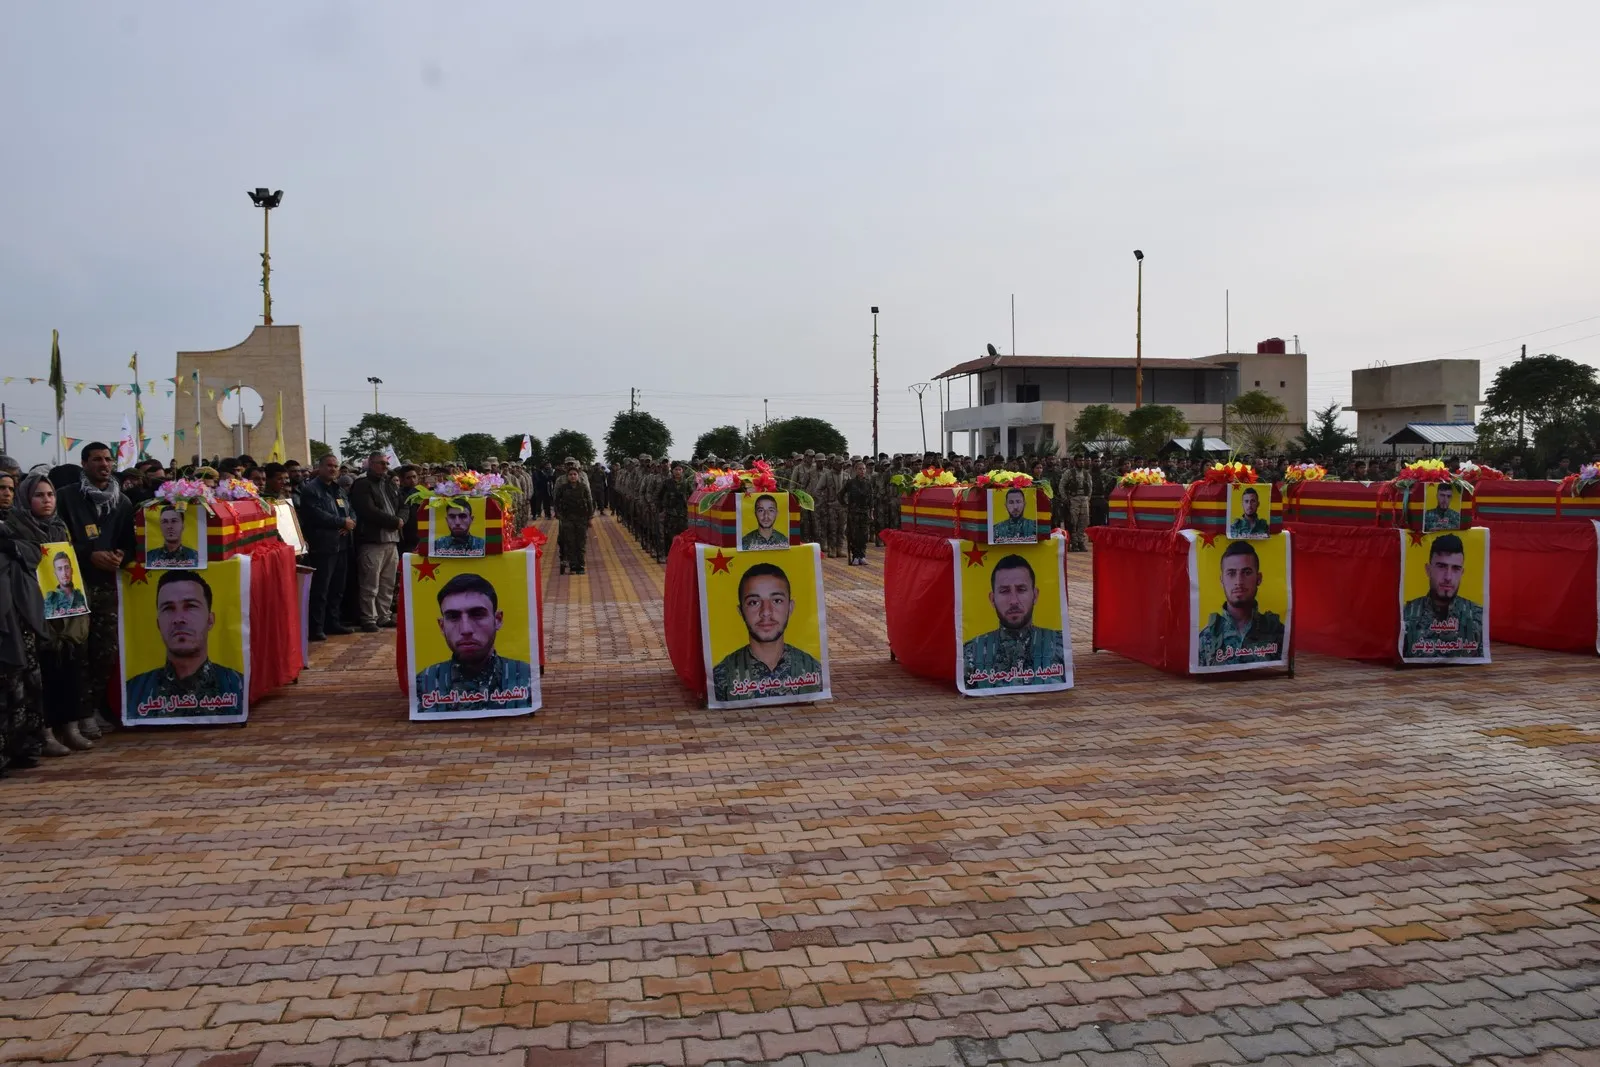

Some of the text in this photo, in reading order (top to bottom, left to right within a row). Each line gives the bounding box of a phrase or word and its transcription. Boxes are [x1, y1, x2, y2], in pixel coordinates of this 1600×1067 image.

[1430, 616, 1459, 633] الشهيد
[1235, 645, 1253, 657] محمد
[1254, 642, 1278, 657] الشهيد
[967, 669, 989, 685] خضر
[1036, 663, 1064, 680] الشهيد
[730, 672, 820, 696] الشهيد عدي عزيز
[138, 692, 238, 716] الشهيد نضال العلي
[422, 686, 529, 708] الشهيد احمد الصالح
